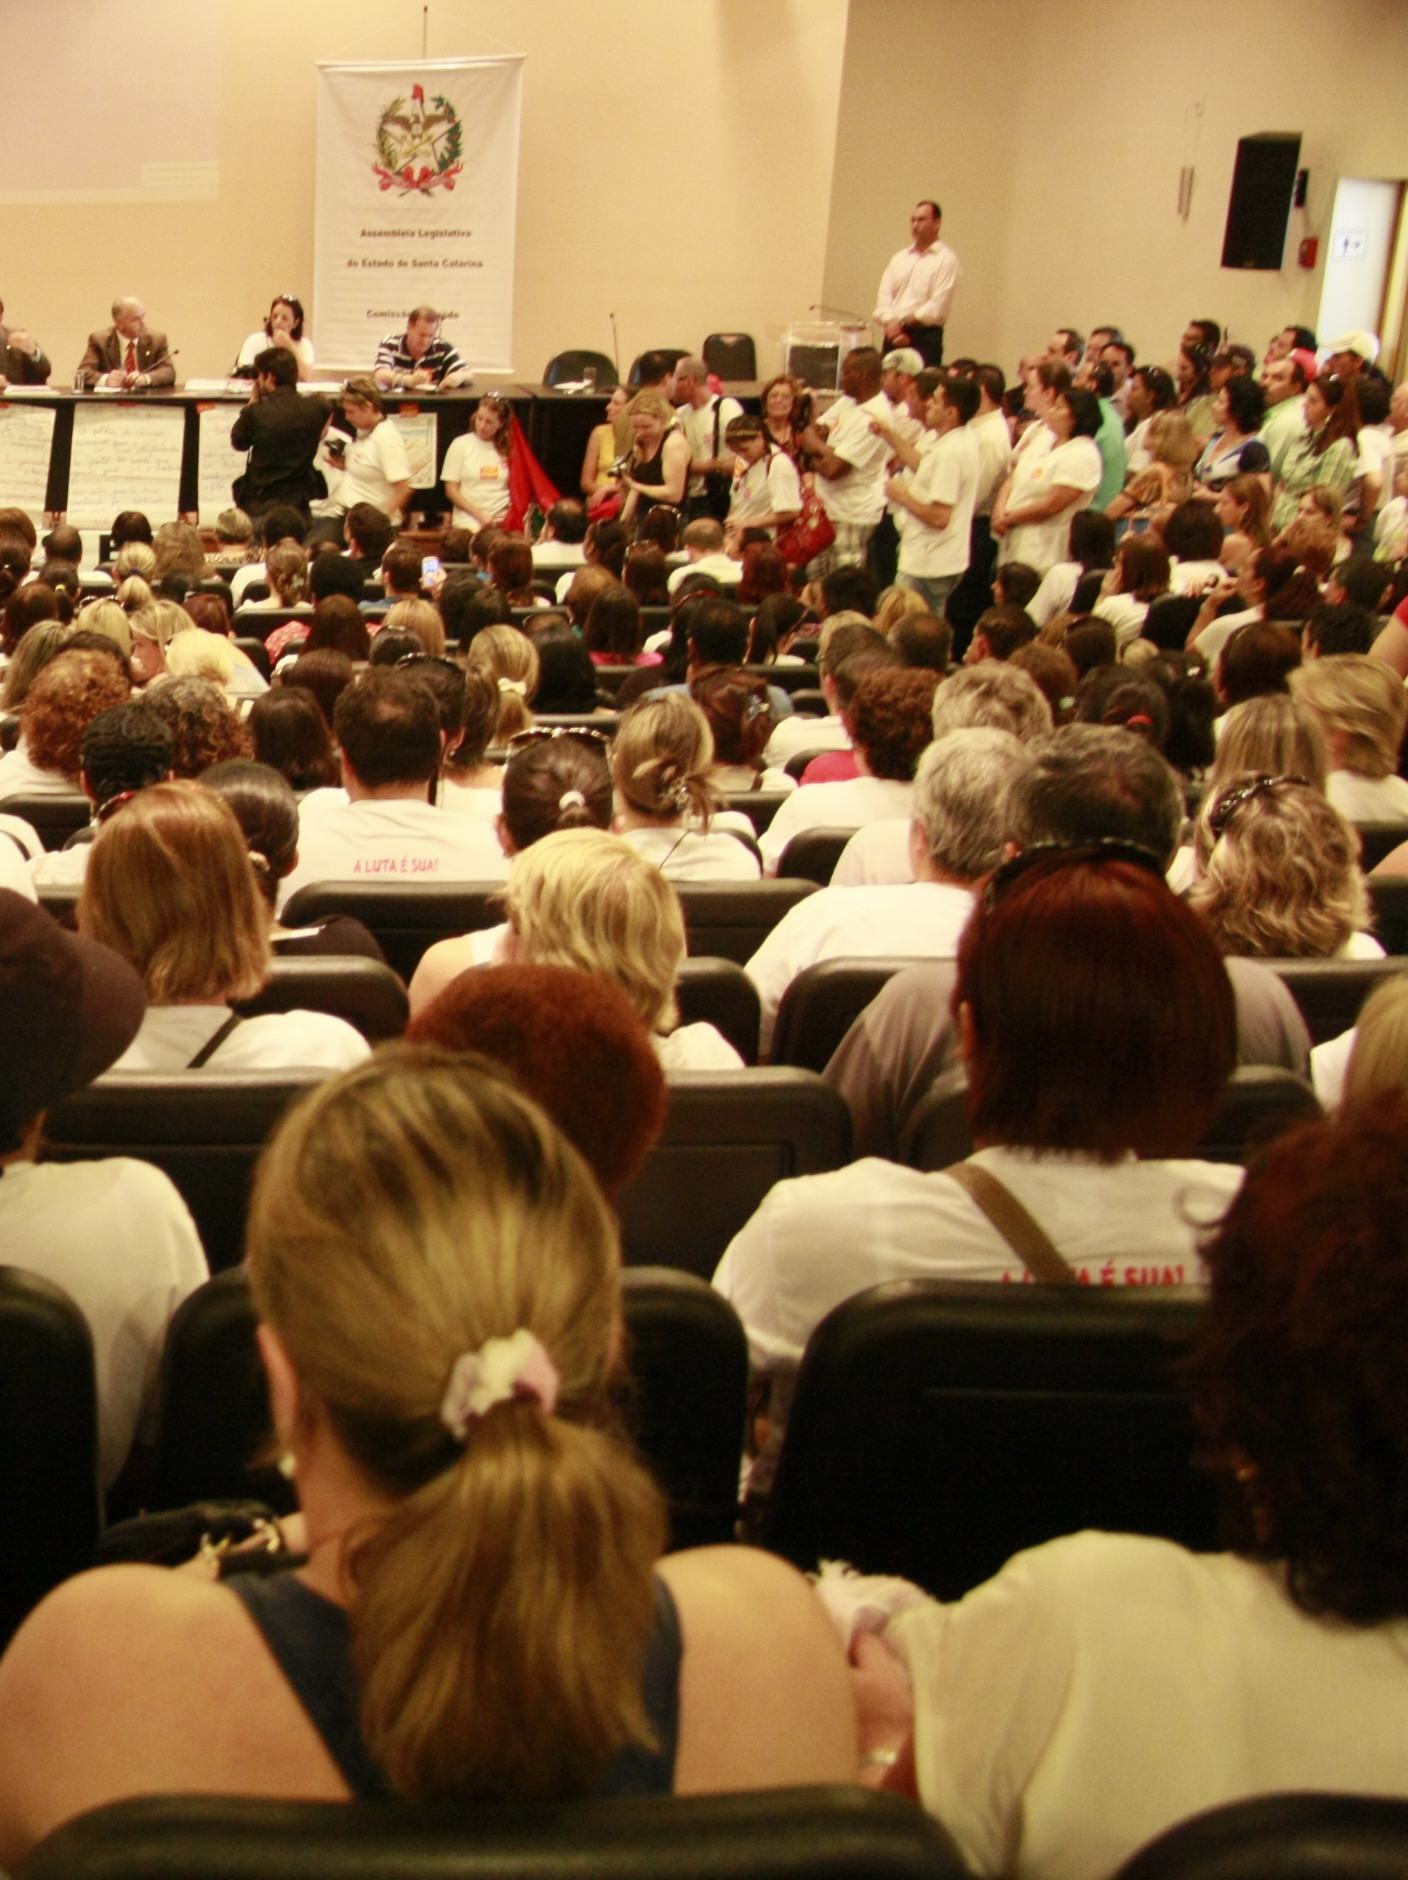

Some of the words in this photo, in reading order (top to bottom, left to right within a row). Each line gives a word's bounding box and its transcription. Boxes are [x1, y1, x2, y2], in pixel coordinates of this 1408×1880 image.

[418, 229, 472, 240] Legislativa
[346, 258, 359, 268] do
[361, 258, 394, 268] Estado
[396, 258, 408, 268] de
[412, 258, 439, 268] Santa
[442, 258, 483, 268] Catarina
[354, 859, 361, 873] A
[365, 858, 397, 873] LUTA
[401, 856, 408, 872] É
[411, 858, 439, 873] SUA!
